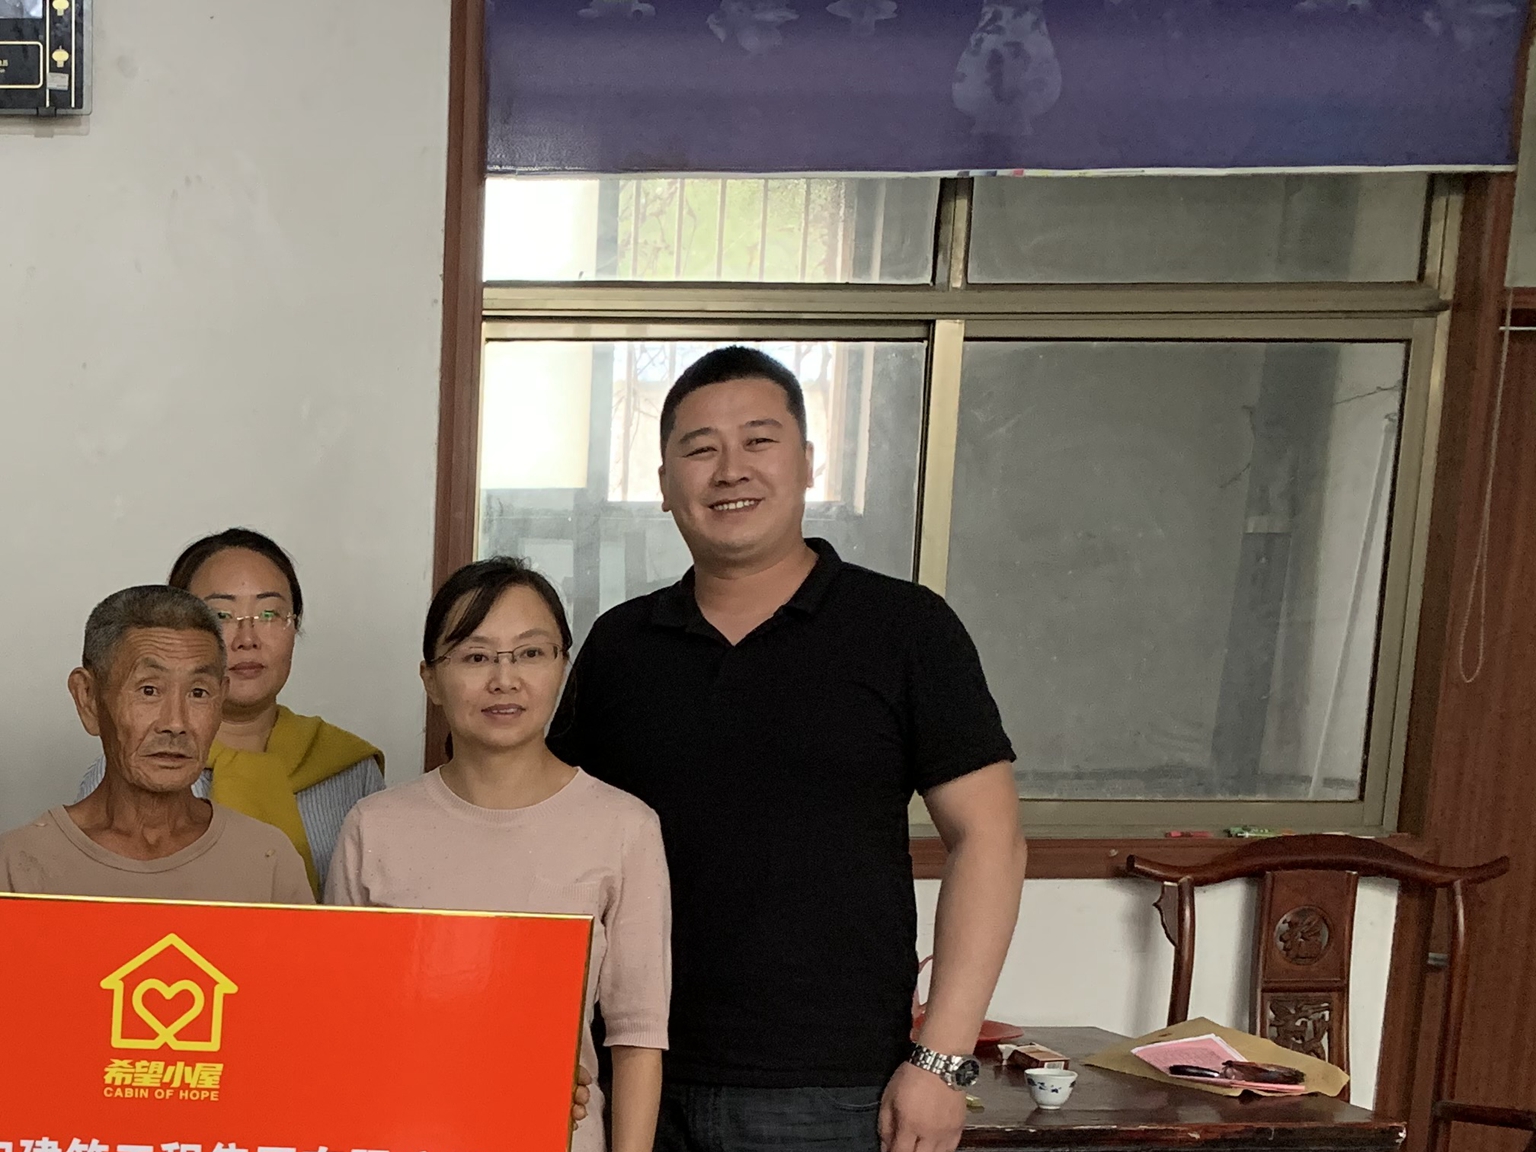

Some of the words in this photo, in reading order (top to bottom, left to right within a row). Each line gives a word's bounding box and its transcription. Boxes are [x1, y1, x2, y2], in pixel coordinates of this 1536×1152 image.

[103, 1058, 224, 1088] 希望小屋
[103, 1087, 149, 1099] CABIN
[154, 1089, 174, 1099] OF
[179, 1090, 219, 1101] HOPE
